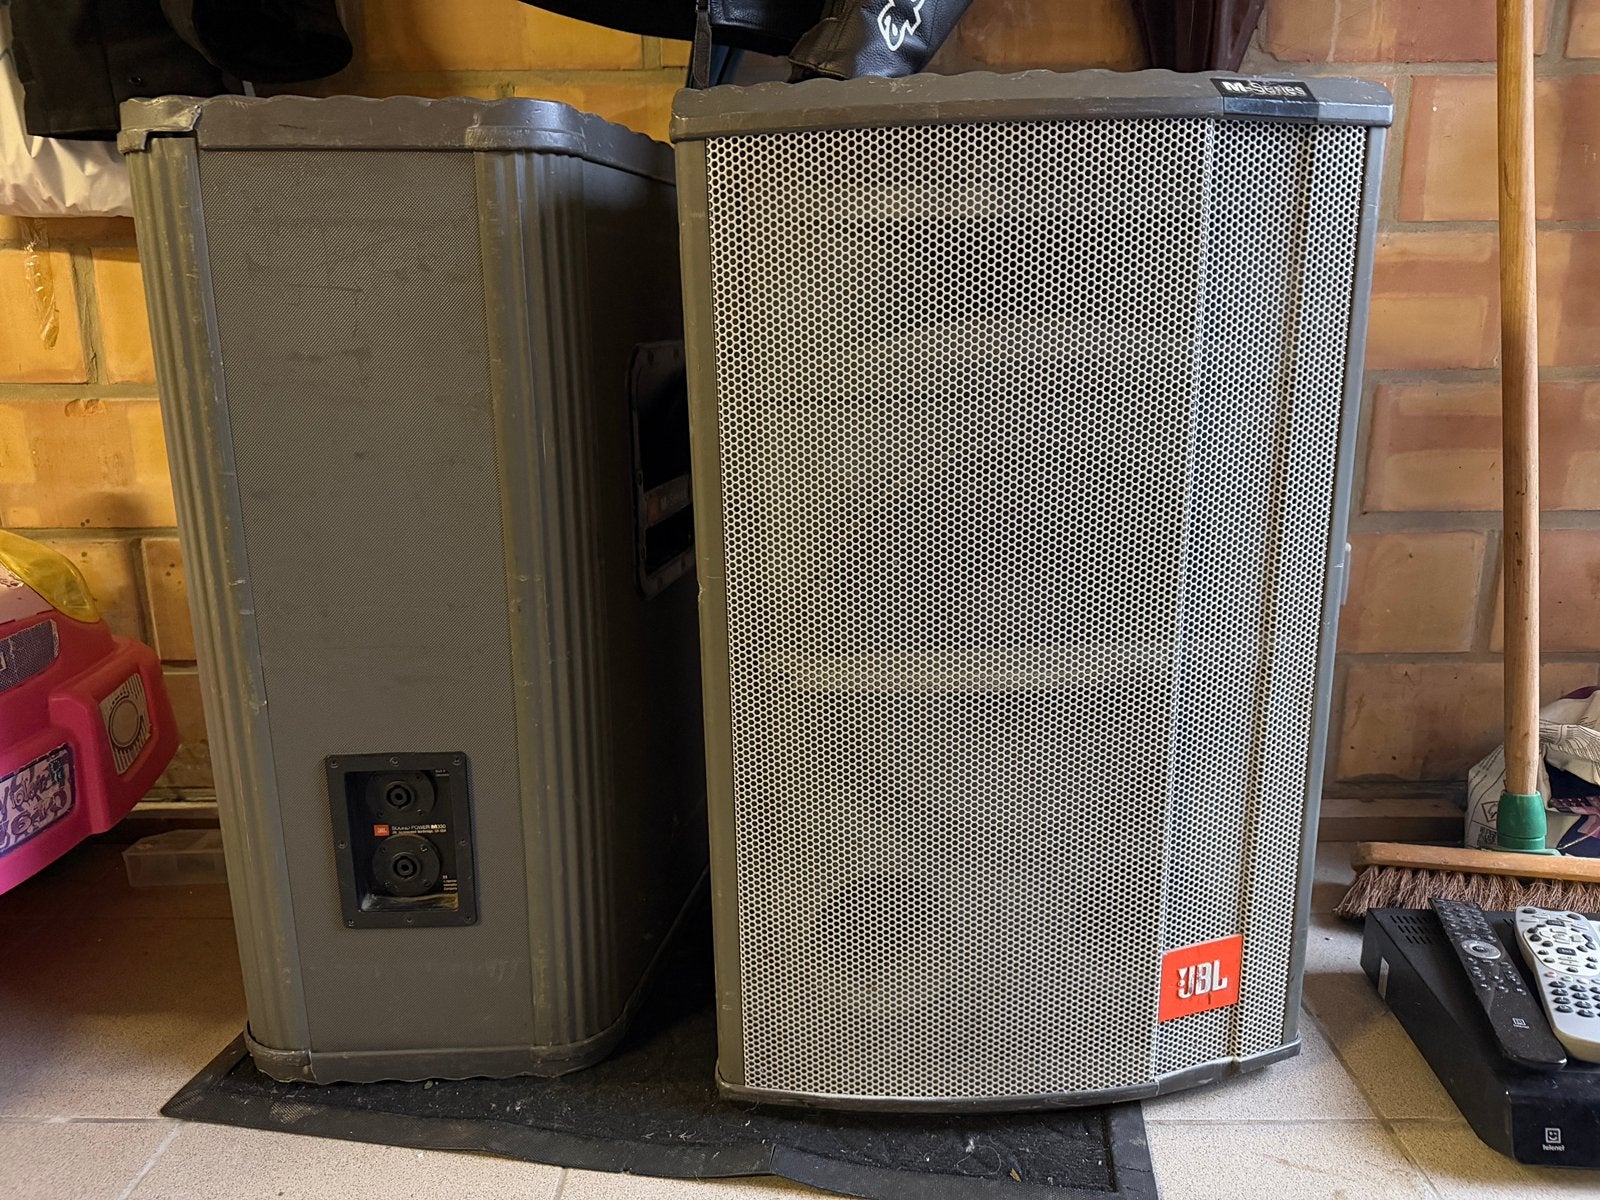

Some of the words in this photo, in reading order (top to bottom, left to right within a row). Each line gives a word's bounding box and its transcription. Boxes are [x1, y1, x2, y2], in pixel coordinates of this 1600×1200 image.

[1221, 81, 1307, 97] M-Series
[1177, 959, 1228, 999] JBL
[1542, 1144, 1565, 1152] telenet
